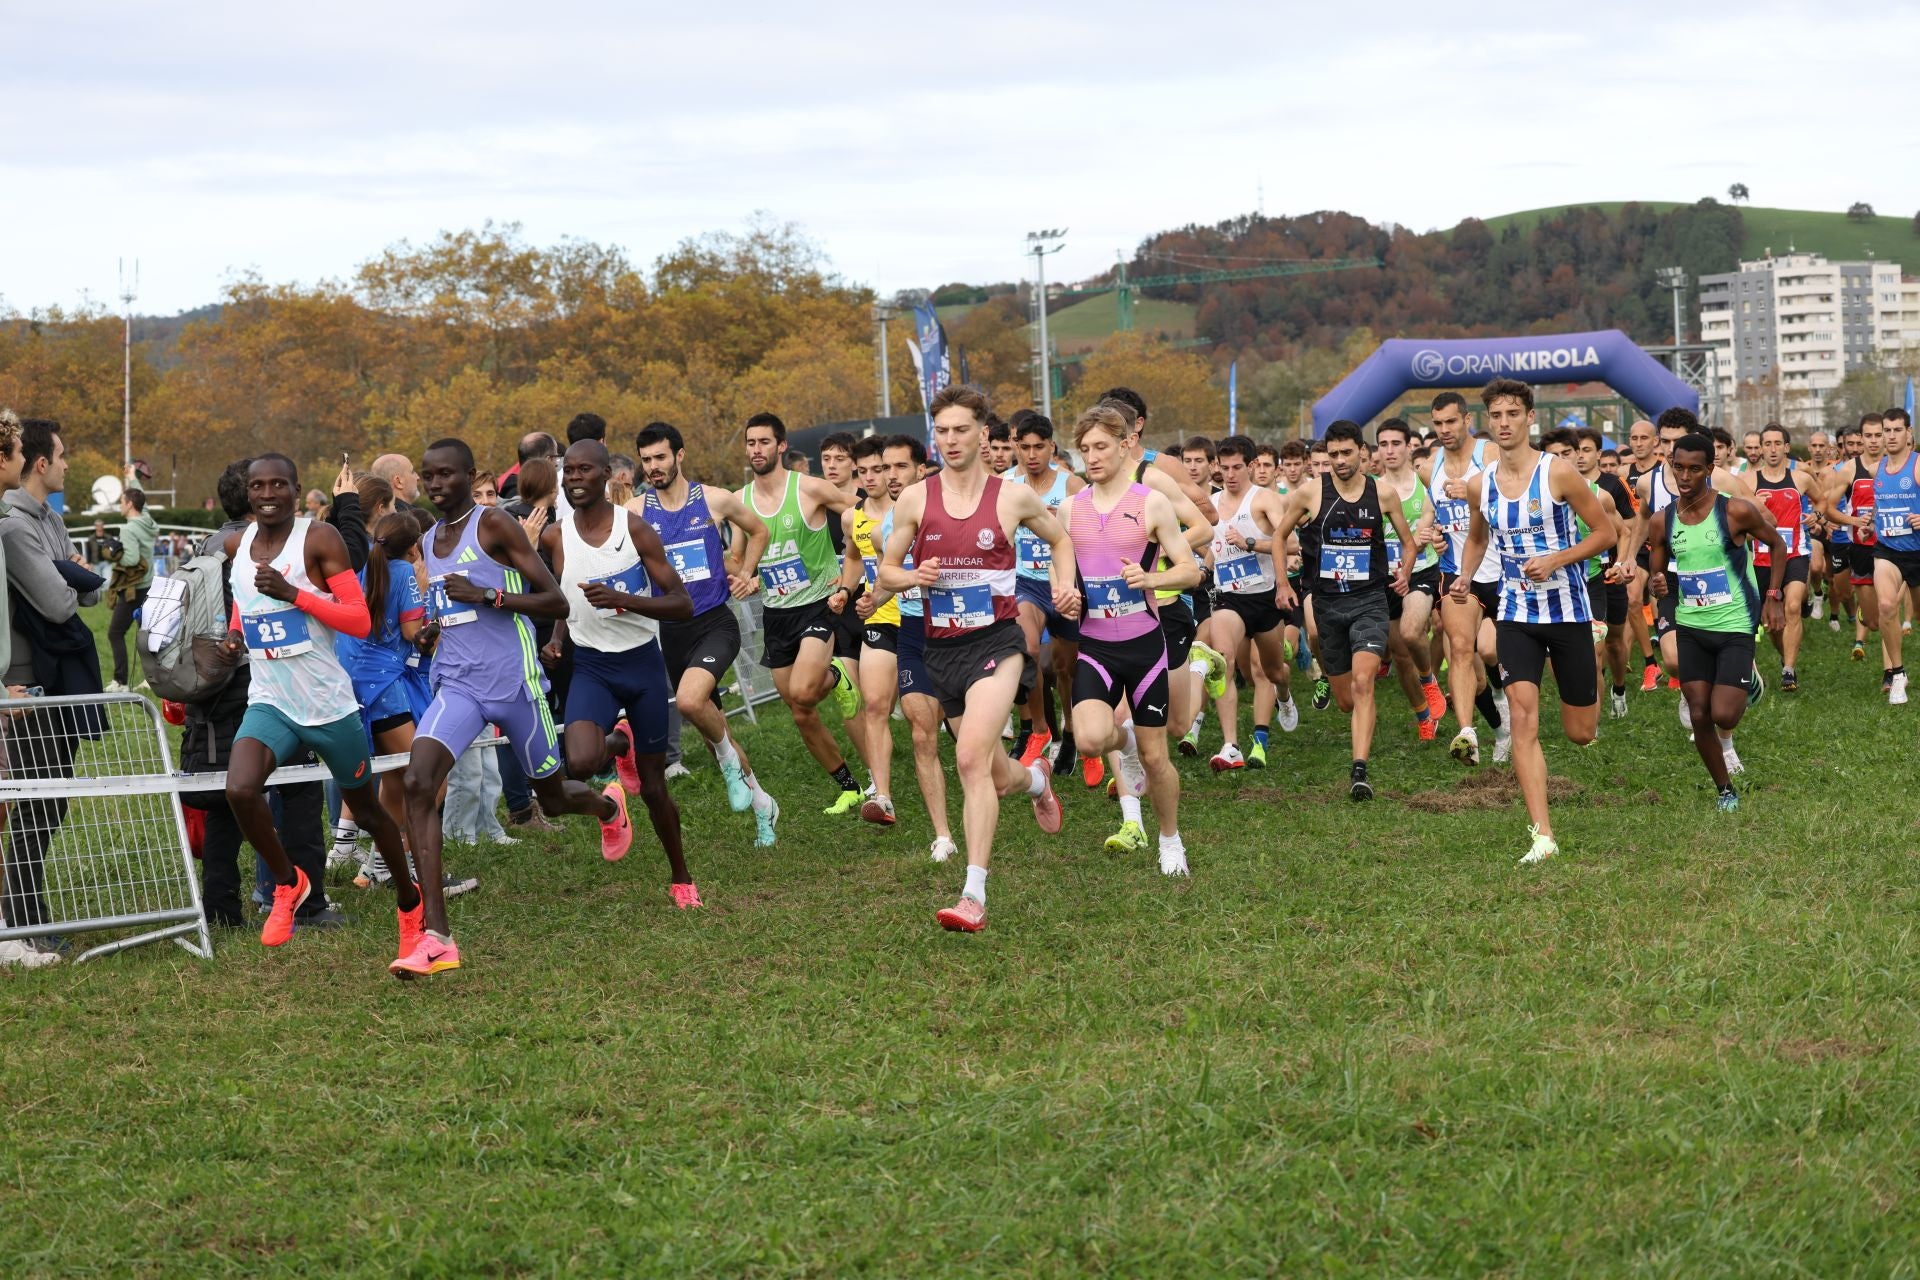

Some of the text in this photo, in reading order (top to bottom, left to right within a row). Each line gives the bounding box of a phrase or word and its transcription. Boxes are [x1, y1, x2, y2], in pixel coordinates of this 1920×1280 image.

[1447, 346, 1600, 375] ORAINKIROLA
[1882, 515, 1904, 528] 110
[1507, 525, 1544, 535] GIPUZKOA
[1031, 543, 1051, 557] 23
[673, 554, 686, 570] 3
[938, 557, 983, 566] ULLINGAR
[1335, 555, 1355, 569] 95
[768, 566, 798, 584] 158
[939, 572, 980, 580] ARRIERS
[1228, 562, 1246, 579] 11
[1696, 580, 1708, 594] 9
[1107, 587, 1120, 603] 4
[952, 595, 966, 613] 5
[257, 620, 287, 643] 25
